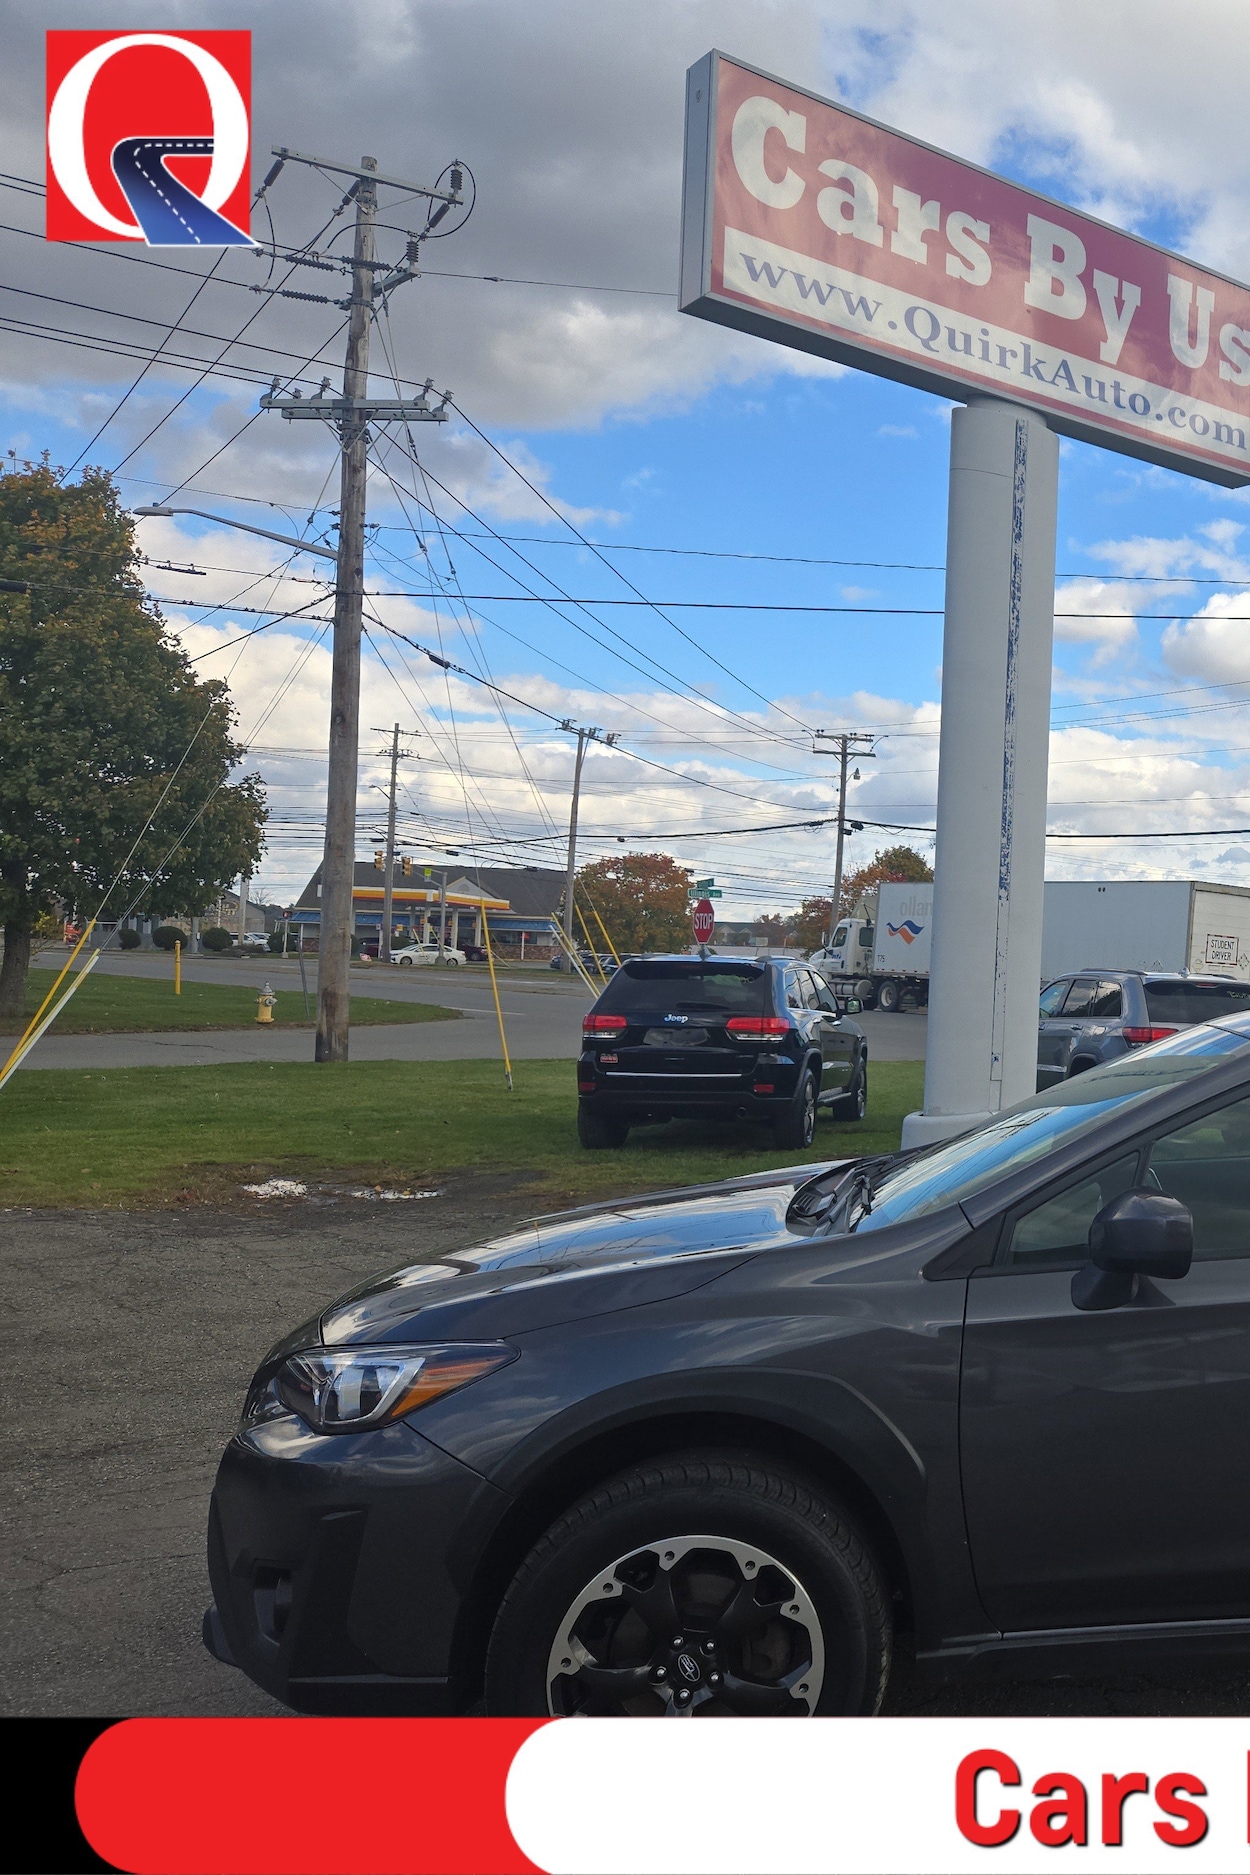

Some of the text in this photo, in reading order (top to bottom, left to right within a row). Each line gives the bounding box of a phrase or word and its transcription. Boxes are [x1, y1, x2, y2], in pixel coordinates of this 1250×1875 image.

[731, 95, 993, 287] Cars
[1023, 212, 1142, 363] By
[739, 251, 1248, 451] www.QuirkAuto.com
[695, 913, 712, 930] STOP
[1211, 940, 1235, 950] STUDENT
[1212, 951, 1232, 960] DRIVER
[664, 1014, 688, 1023] Jeep
